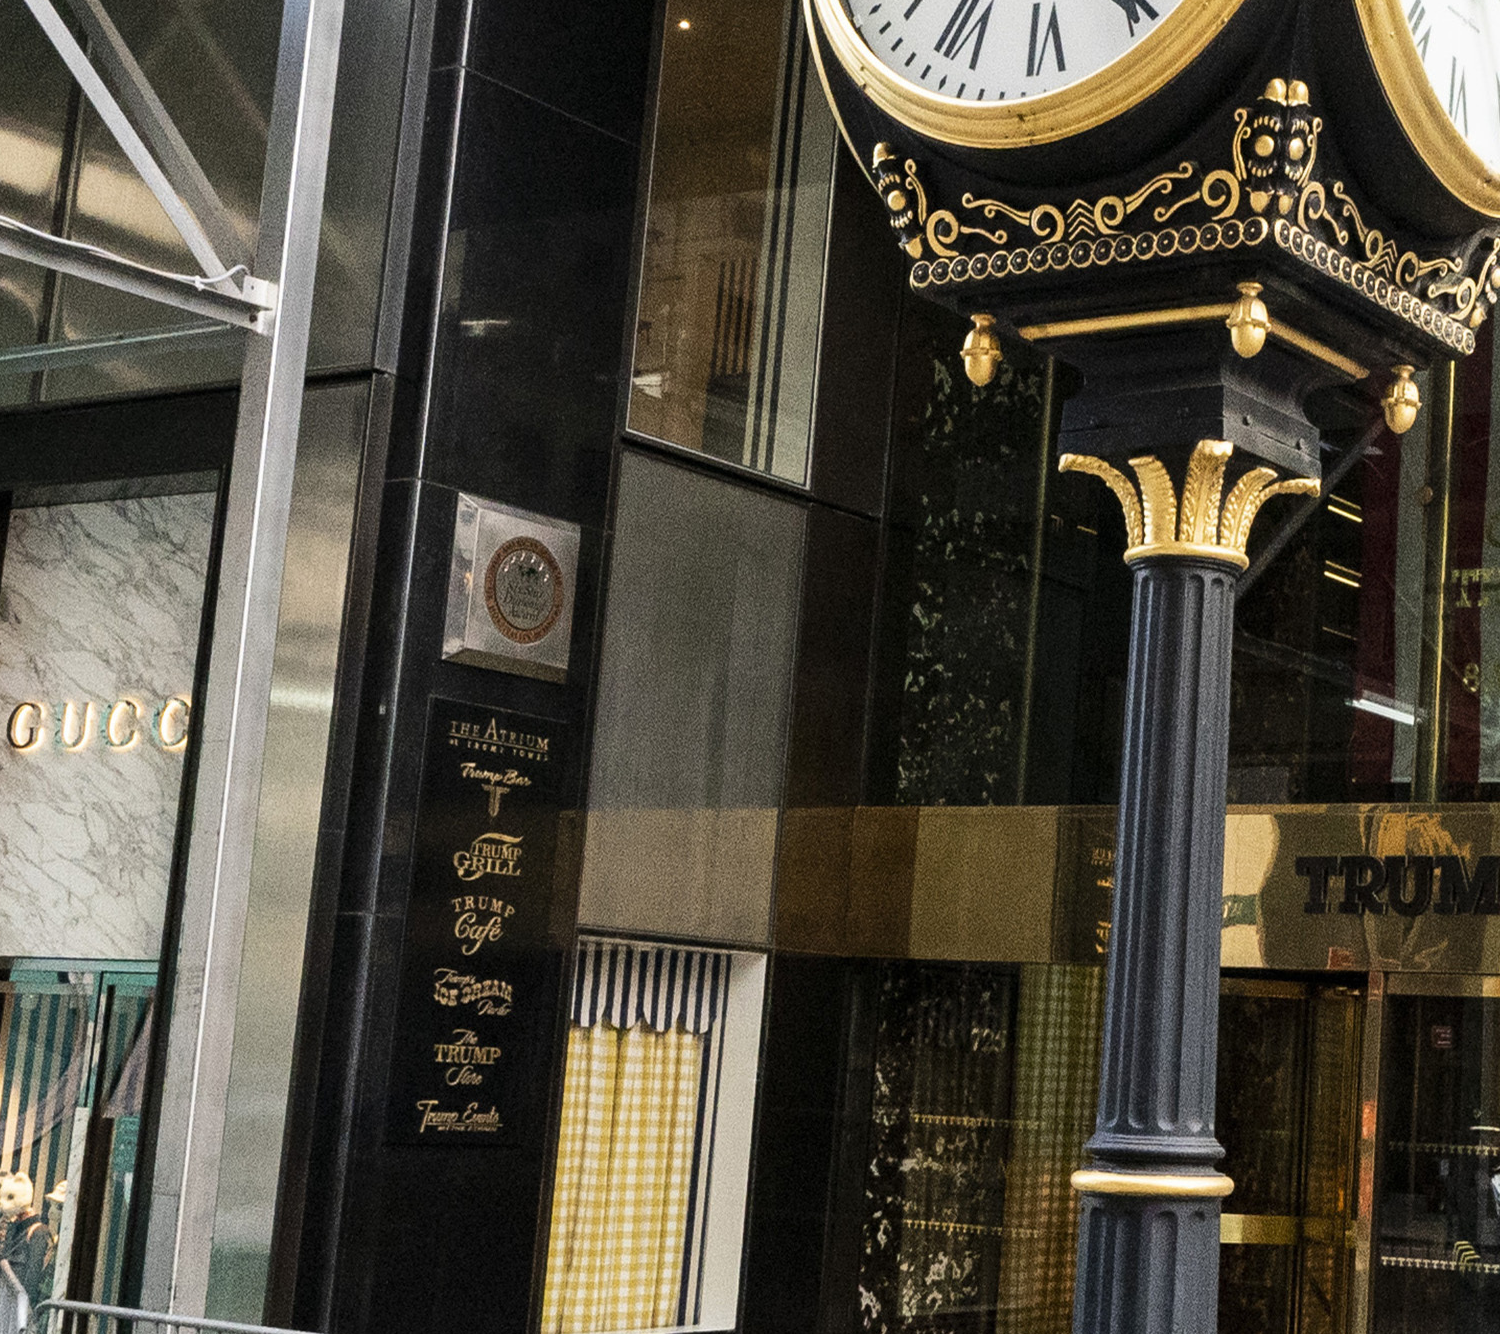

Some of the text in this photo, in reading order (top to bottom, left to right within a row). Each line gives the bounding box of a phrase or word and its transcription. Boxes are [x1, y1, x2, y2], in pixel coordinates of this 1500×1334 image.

[6, 697, 193, 750] GUCC
[450, 717, 549, 751] THE ATRIUM
[460, 762, 532, 786] Trump Bar
[471, 835, 523, 862] TRUMP
[453, 851, 522, 881] GRILL
[451, 895, 516, 918] TRUMP
[454, 912, 504, 956] Café
[452, 1028, 478, 1046] The
[434, 1044, 502, 1065] TRUMP
[416, 1100, 459, 1133] Trump
